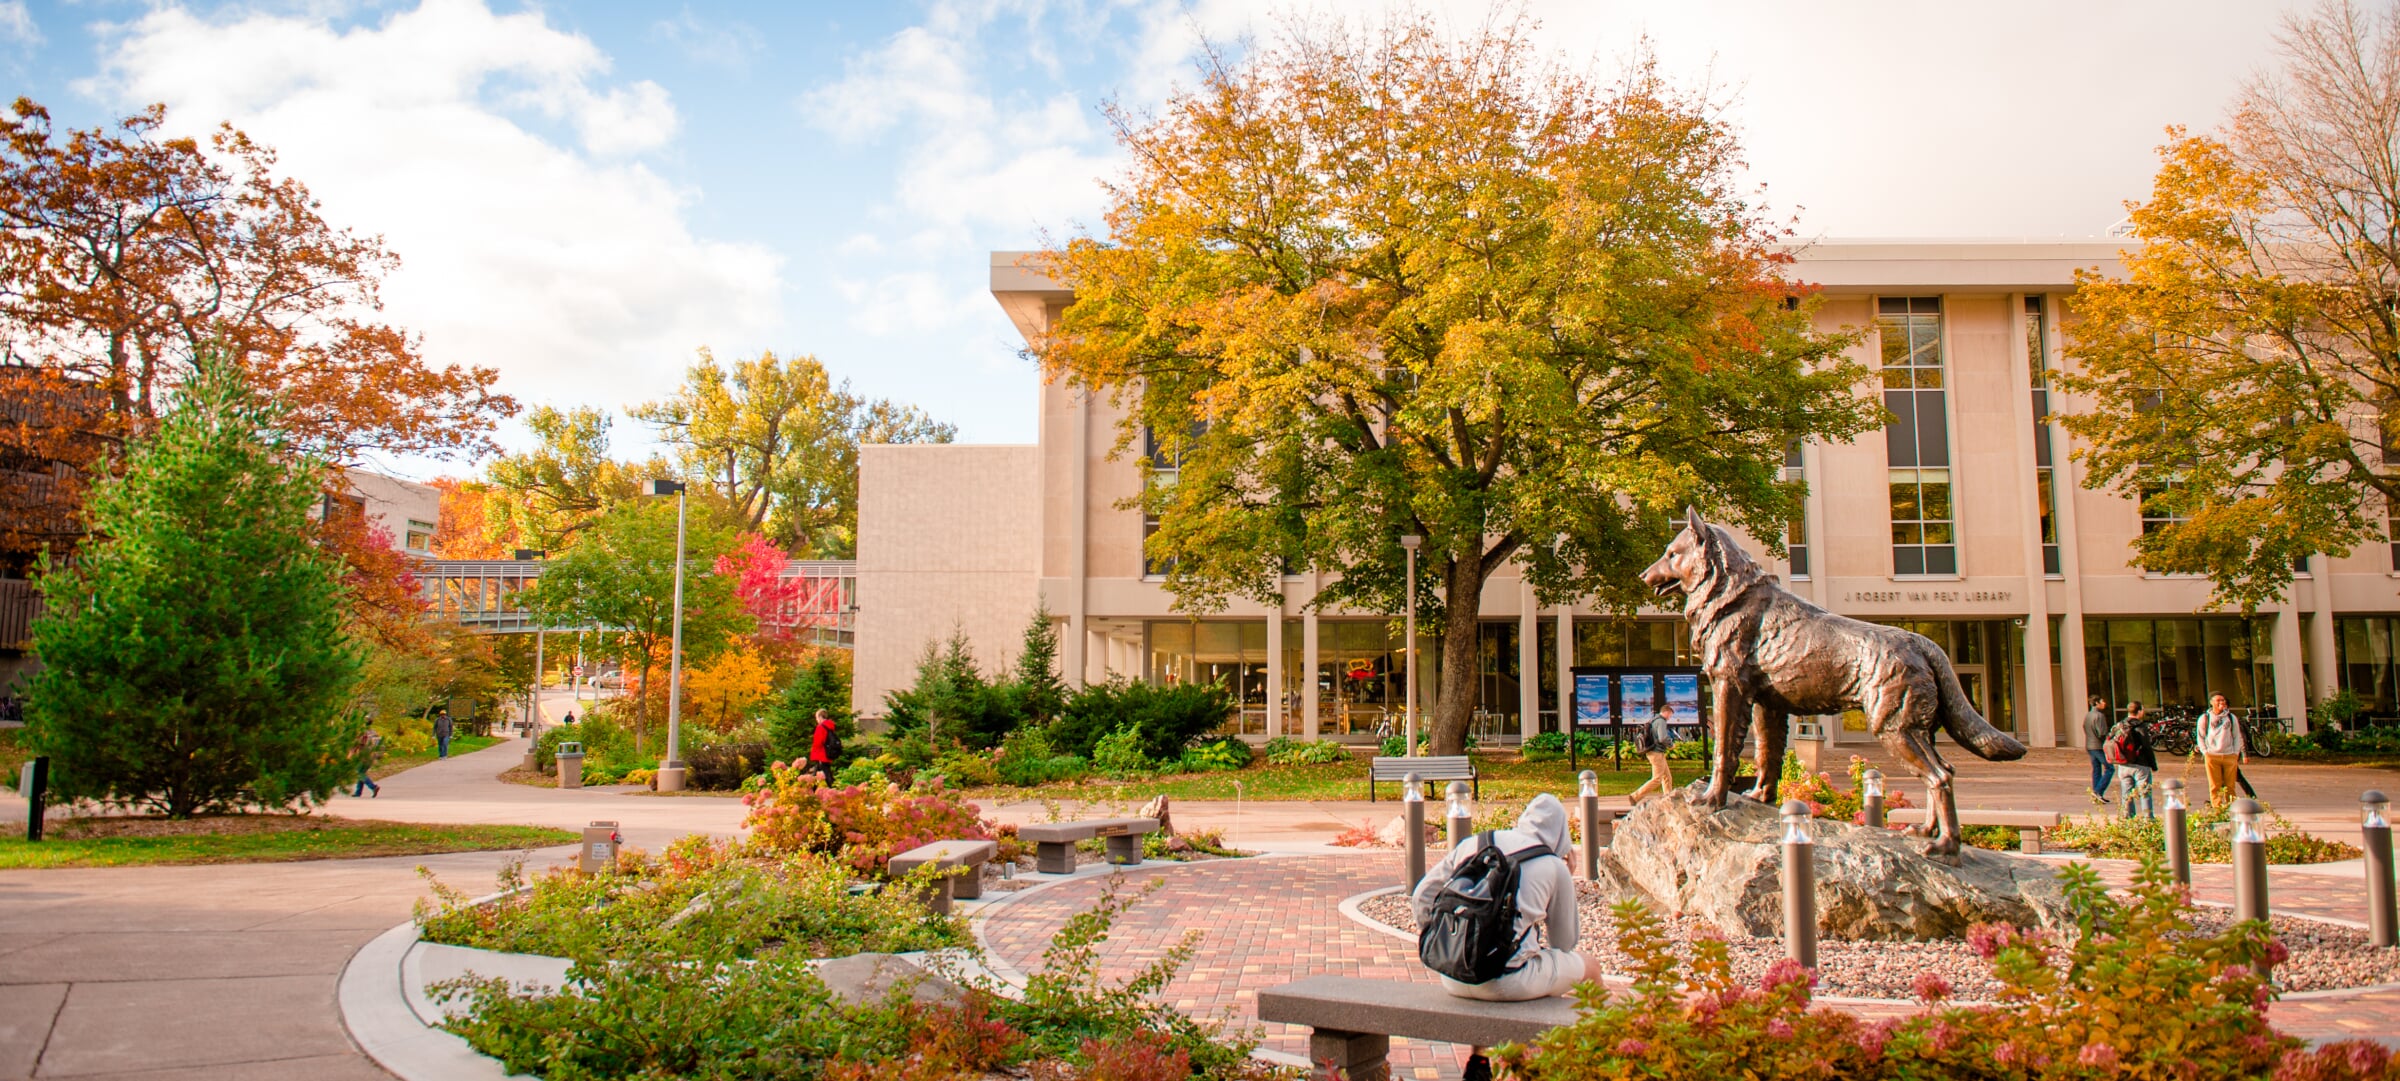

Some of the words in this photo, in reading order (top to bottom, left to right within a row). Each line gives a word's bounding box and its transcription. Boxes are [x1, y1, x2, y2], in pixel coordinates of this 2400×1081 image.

[1844, 591, 1851, 603] J
[1855, 591, 1902, 603] ROBERT
[1906, 591, 1928, 603] VAN
[1933, 591, 1960, 603] PELT
[1964, 591, 2012, 603] LIBRARY
